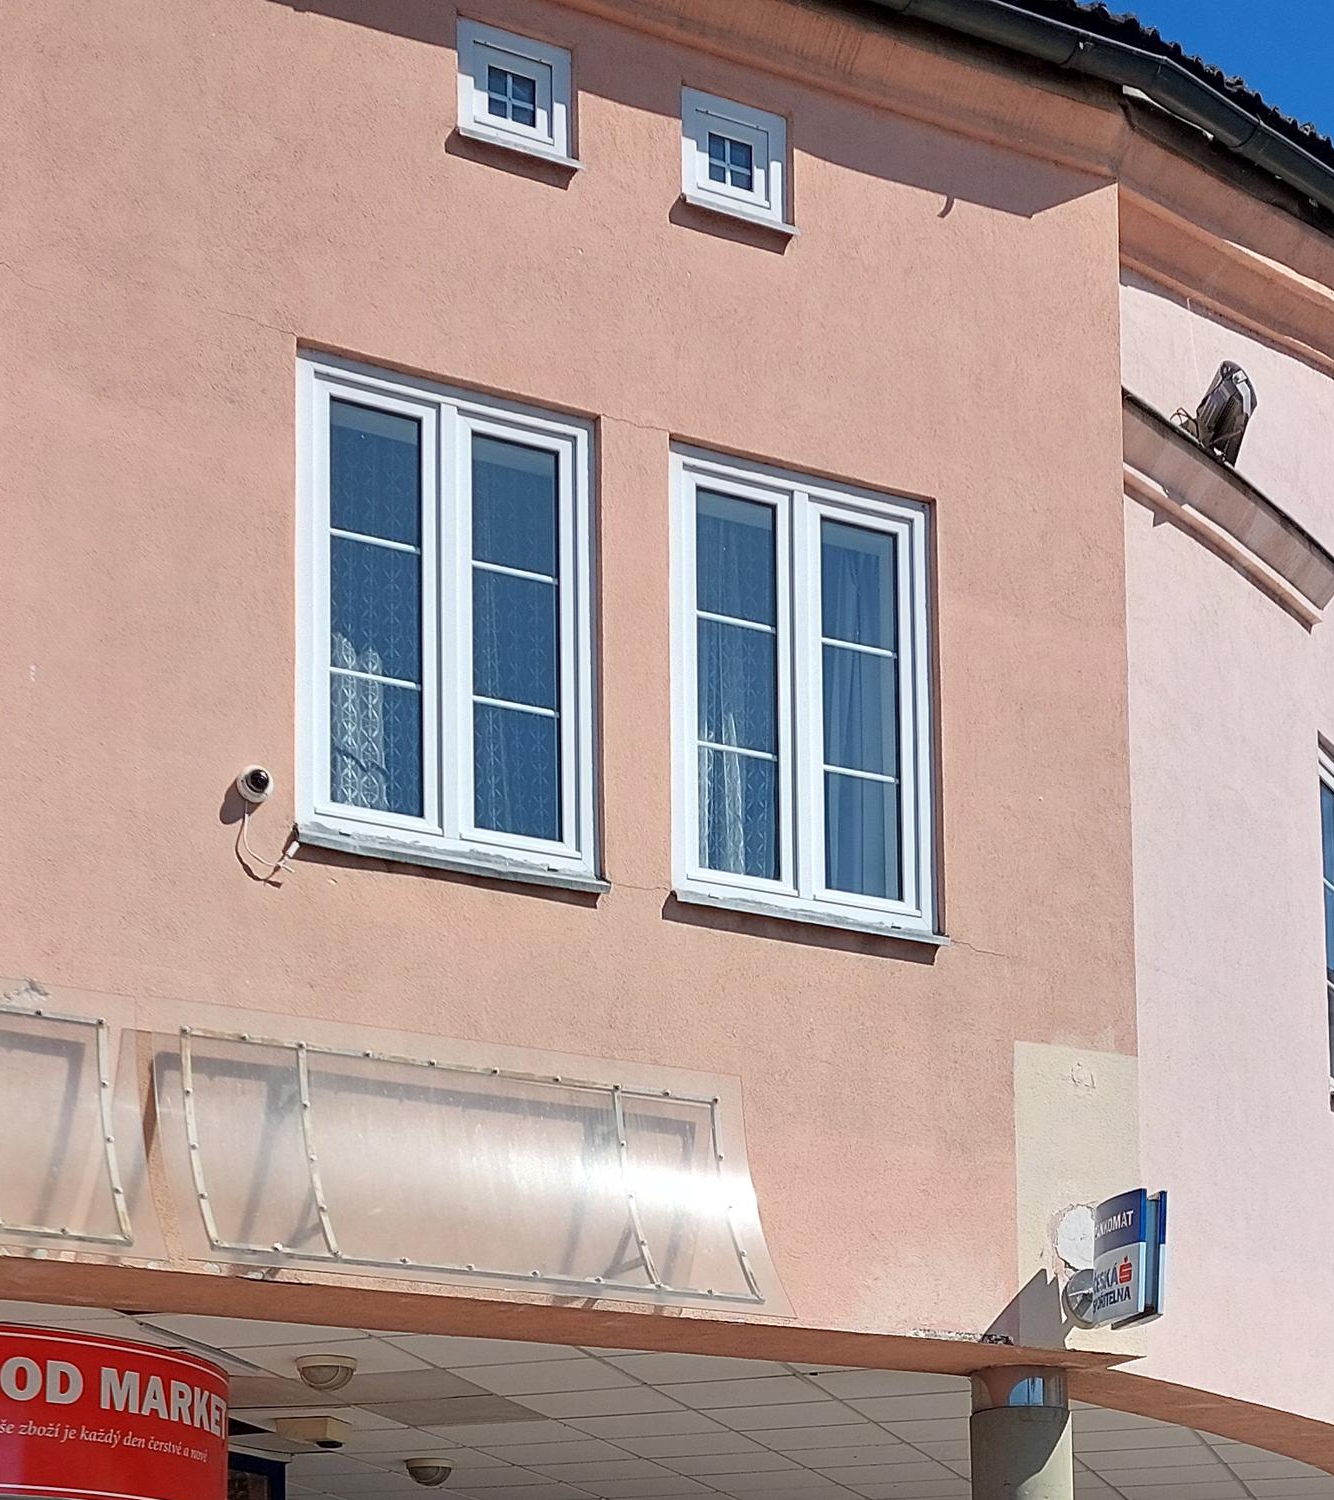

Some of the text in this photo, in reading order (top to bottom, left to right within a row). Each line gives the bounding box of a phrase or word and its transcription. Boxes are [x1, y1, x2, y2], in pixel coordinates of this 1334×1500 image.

[1094, 1209, 1134, 1240] ANKOMAT
[100, 1366, 227, 1441] MARKET
[17, 1420, 61, 1438] zboží
[60, 1425, 78, 1443] je
[79, 1425, 121, 1449] každý
[122, 1431, 146, 1449] den
[147, 1436, 182, 1456] čerstvé
[182, 1446, 190, 1458] a
